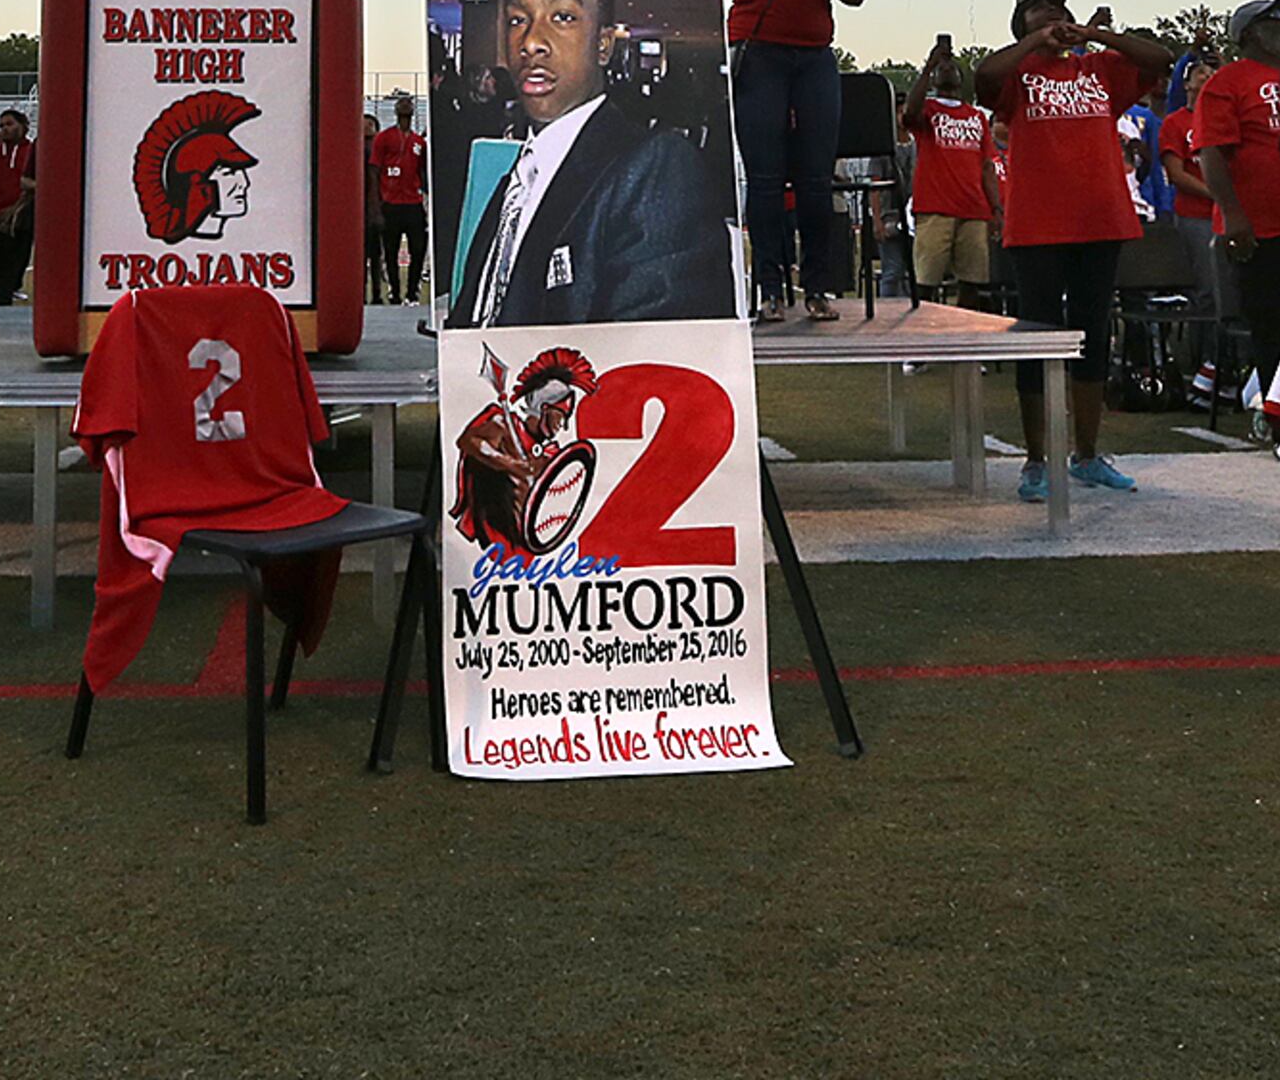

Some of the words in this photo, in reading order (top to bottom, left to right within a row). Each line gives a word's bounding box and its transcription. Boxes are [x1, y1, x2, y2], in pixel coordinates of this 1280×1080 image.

[102, 7, 297, 43] BANNEKER
[153, 47, 245, 84] HIGH
[98, 251, 295, 289] TROJANS
[187, 338, 246, 442] 2
[576, 363, 737, 568] 2
[469, 542, 622, 598] Jaylen
[452, 576, 745, 639] MUMFORD
[456, 642, 492, 680] July
[497, 640, 525, 671] 25,
[490, 686, 562, 720] Heroes
[568, 691, 602, 714] are
[605, 673, 736, 714] remembered.
[463, 716, 592, 770] Legends
[594, 714, 648, 763] live
[653, 710, 771, 761] forever.
